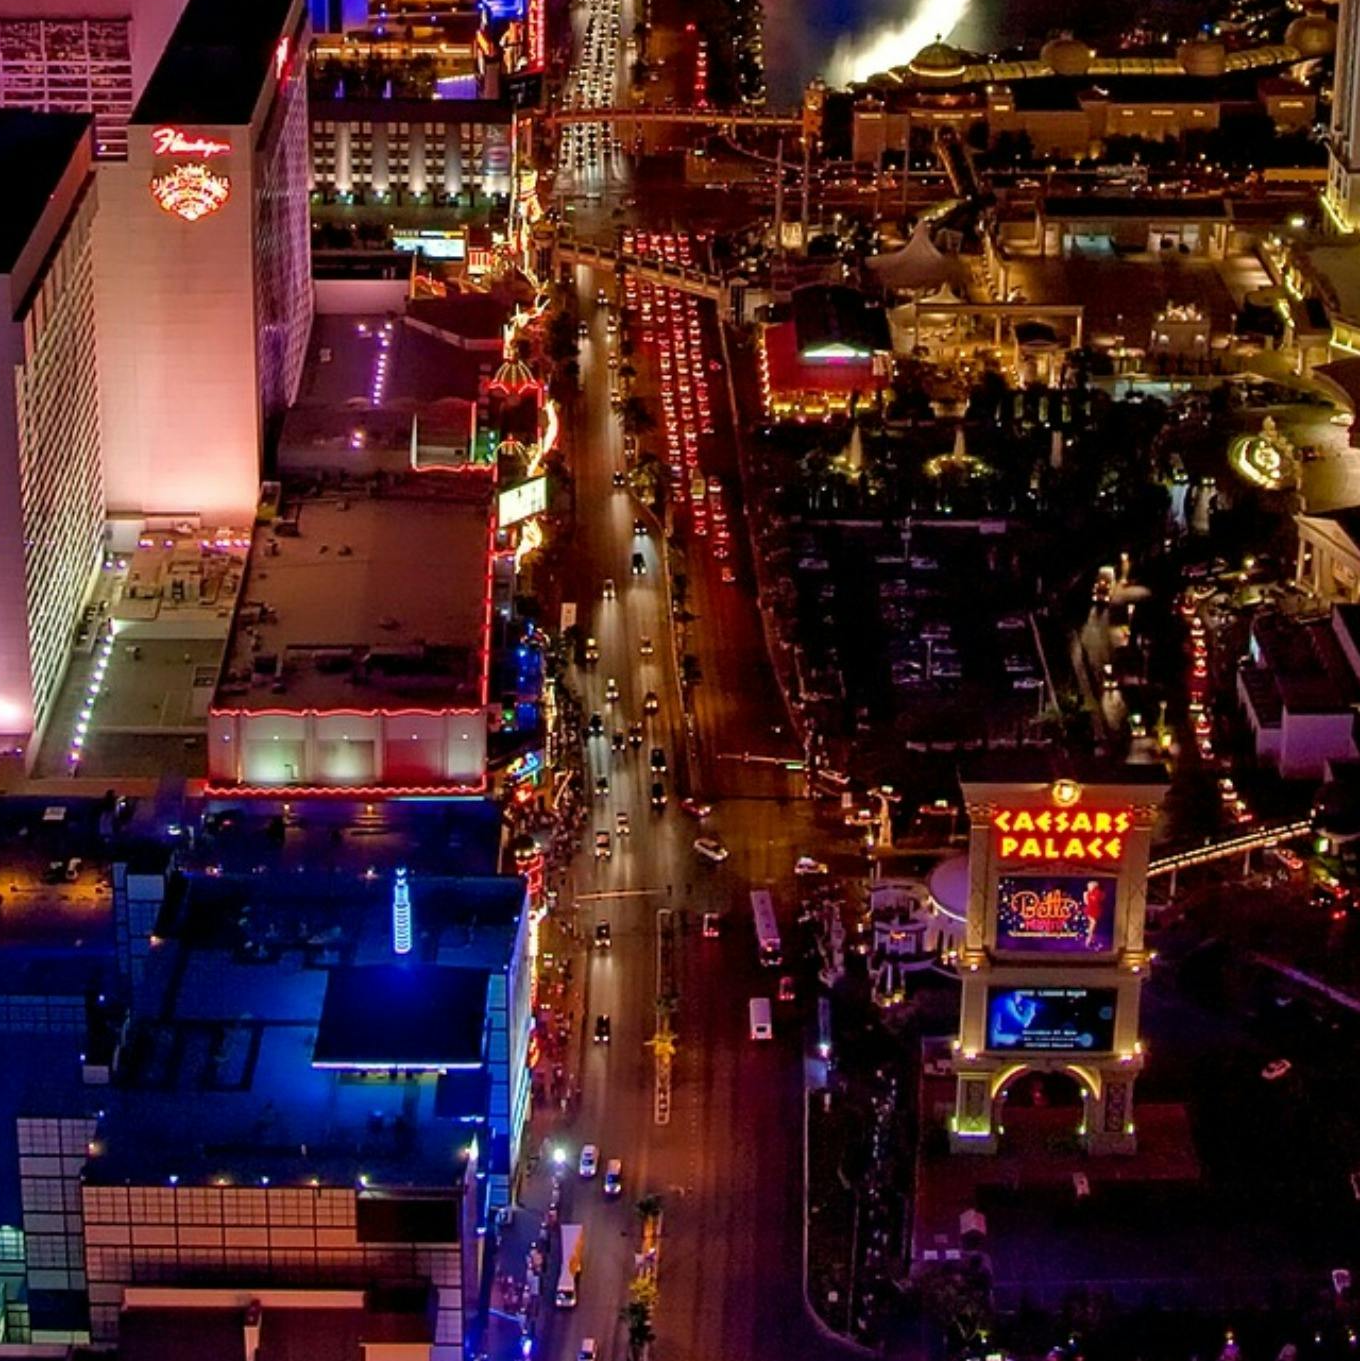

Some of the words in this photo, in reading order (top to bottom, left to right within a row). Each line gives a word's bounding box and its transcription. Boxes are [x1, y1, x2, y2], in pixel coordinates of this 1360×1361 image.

[152, 128, 230, 157] Flamingo
[994, 810, 1130, 833] CAESARS
[1000, 836, 1122, 859] PALACE
